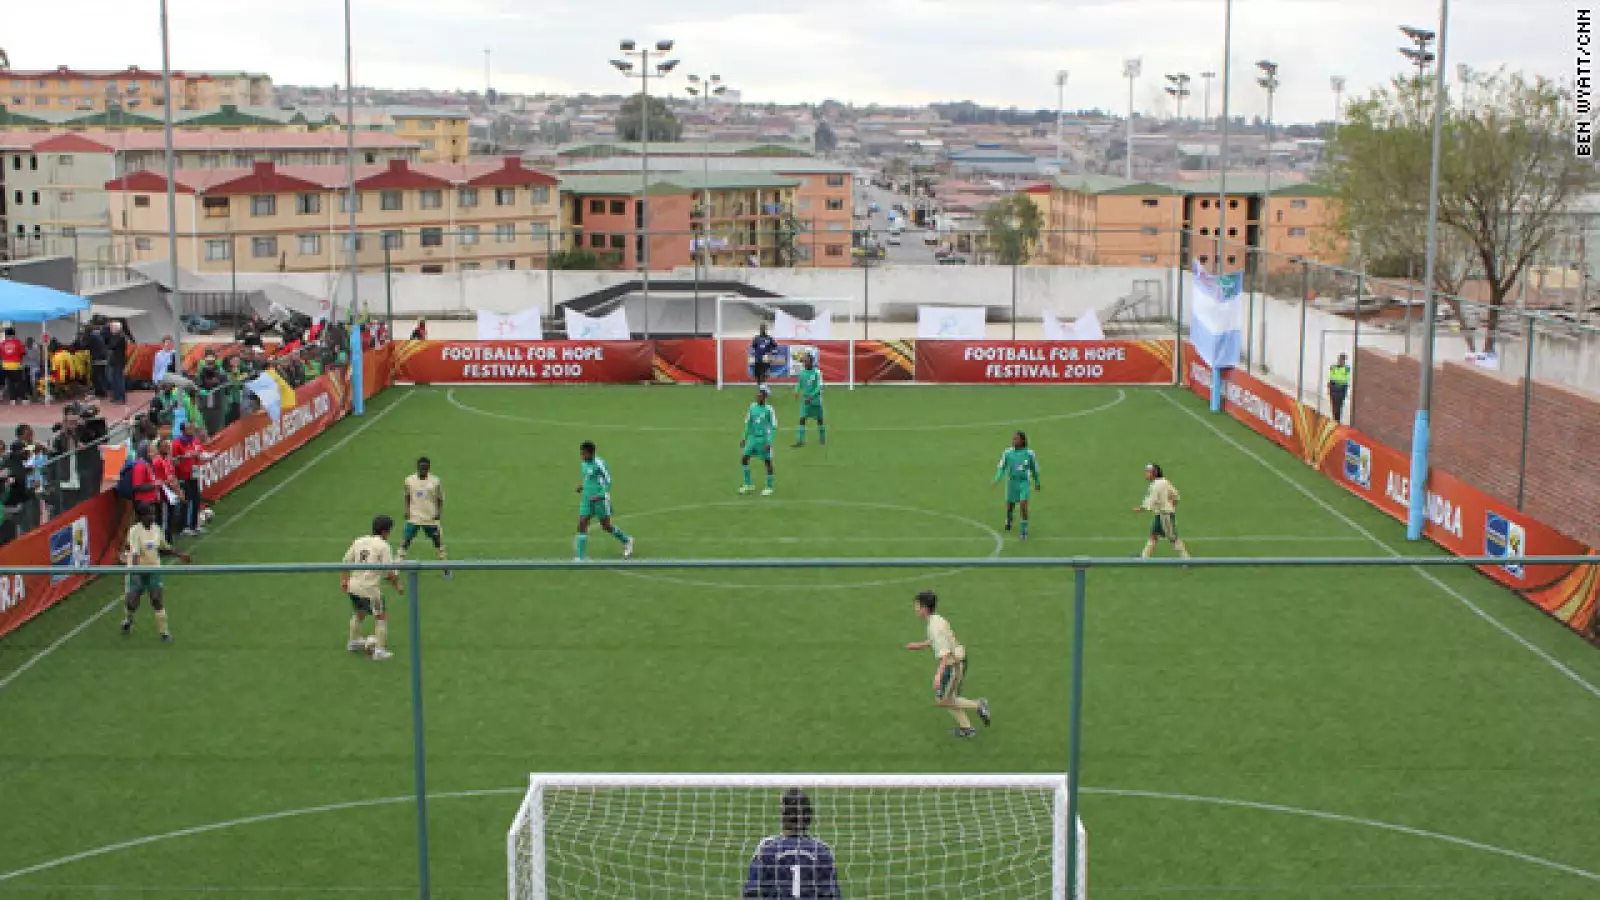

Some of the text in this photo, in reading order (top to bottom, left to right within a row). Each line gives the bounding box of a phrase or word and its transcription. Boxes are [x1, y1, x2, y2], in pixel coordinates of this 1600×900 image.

[441, 346, 604, 361] FOOTBALL FOR HOPE
[963, 346, 1126, 361] FOOTBALL FOR HOPE
[463, 364, 583, 378] FESTIVAL 2010
[986, 364, 1104, 379] FESTIVAL 2010
[789, 864, 801, 898] 1
